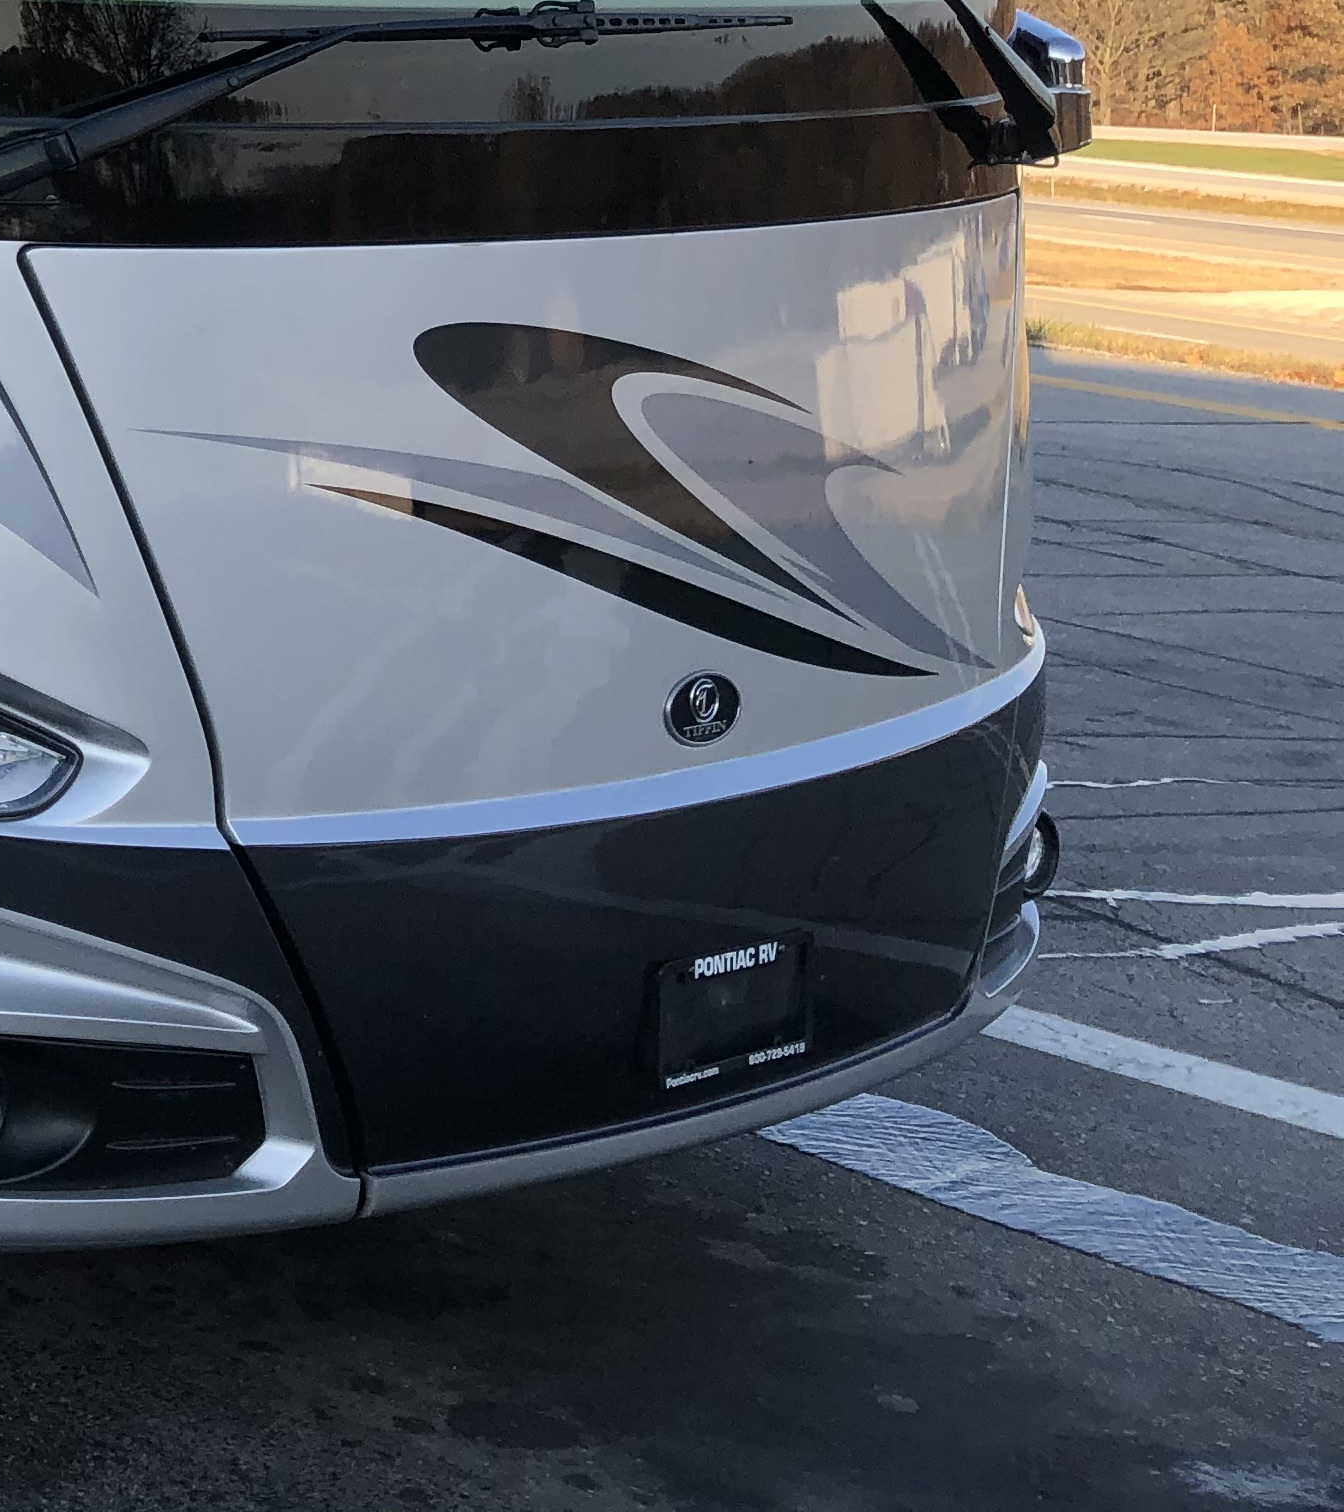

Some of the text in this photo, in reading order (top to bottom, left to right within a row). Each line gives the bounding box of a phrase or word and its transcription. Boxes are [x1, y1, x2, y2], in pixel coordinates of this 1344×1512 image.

[683, 720, 726, 737] TIFFIN
[694, 942, 777, 979] PONTIAC RV
